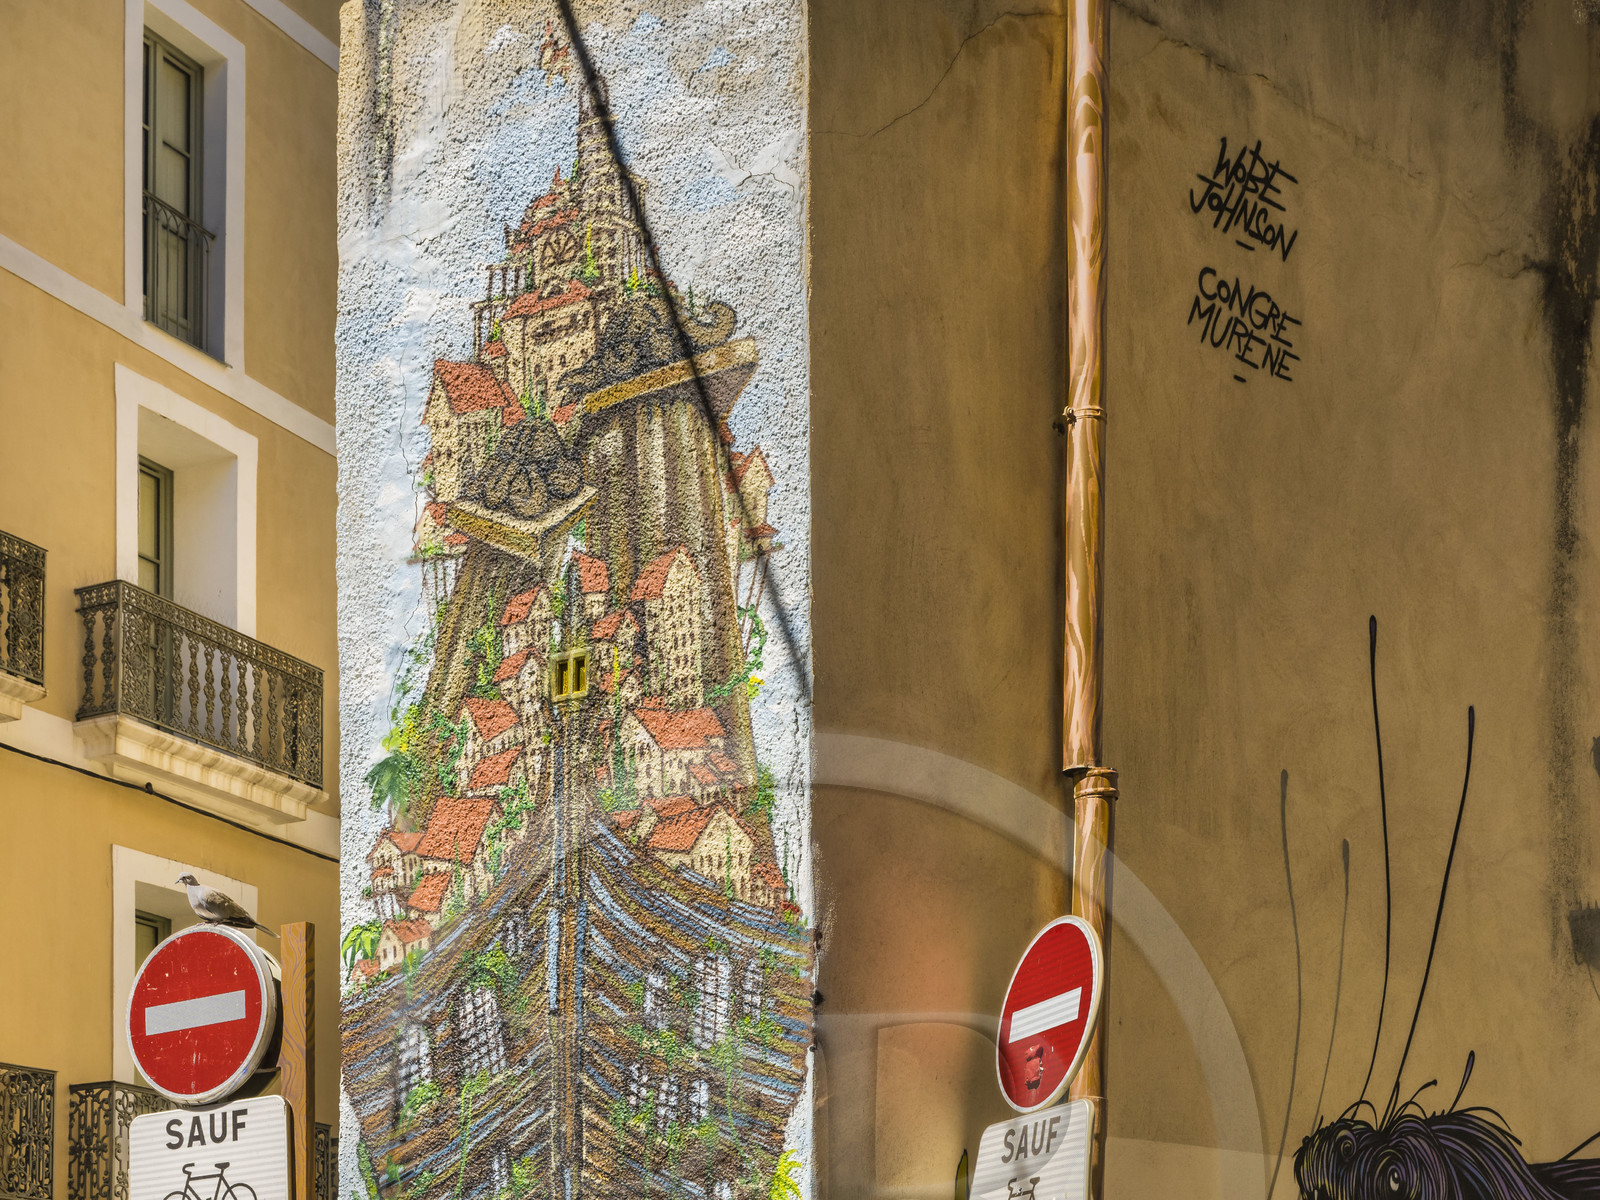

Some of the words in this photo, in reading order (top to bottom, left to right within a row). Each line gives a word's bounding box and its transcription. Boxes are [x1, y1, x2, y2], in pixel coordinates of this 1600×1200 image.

[1189, 173, 1298, 262] JOHNSON
[1187, 294, 1300, 382] MURENE
[1198, 266, 1302, 347] CONGRE
[165, 1108, 248, 1151] SAUF
[1001, 1115, 1061, 1164] SAUF
